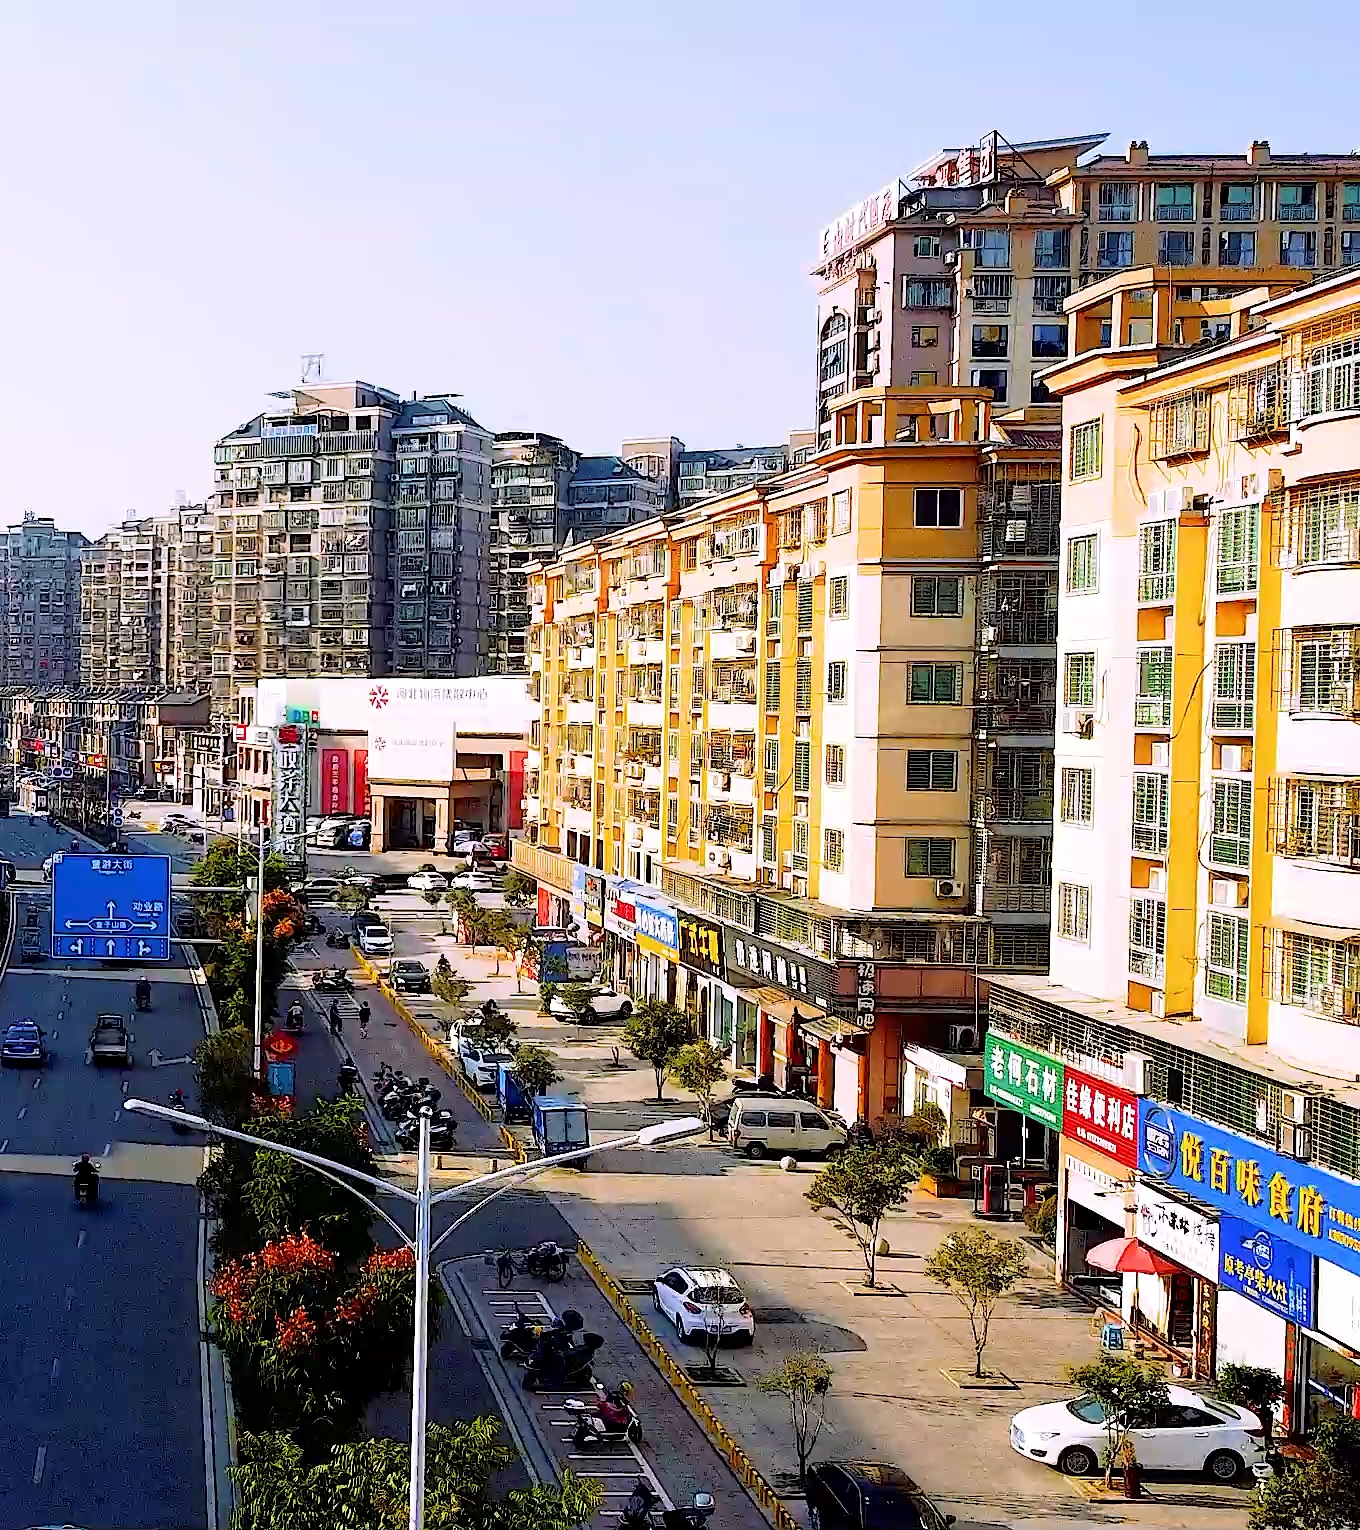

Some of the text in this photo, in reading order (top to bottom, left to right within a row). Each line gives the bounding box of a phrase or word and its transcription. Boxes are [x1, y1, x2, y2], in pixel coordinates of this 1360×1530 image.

[990, 1044, 1057, 1104] 老何石材
[1180, 1130, 1325, 1238] 悦百味食府
